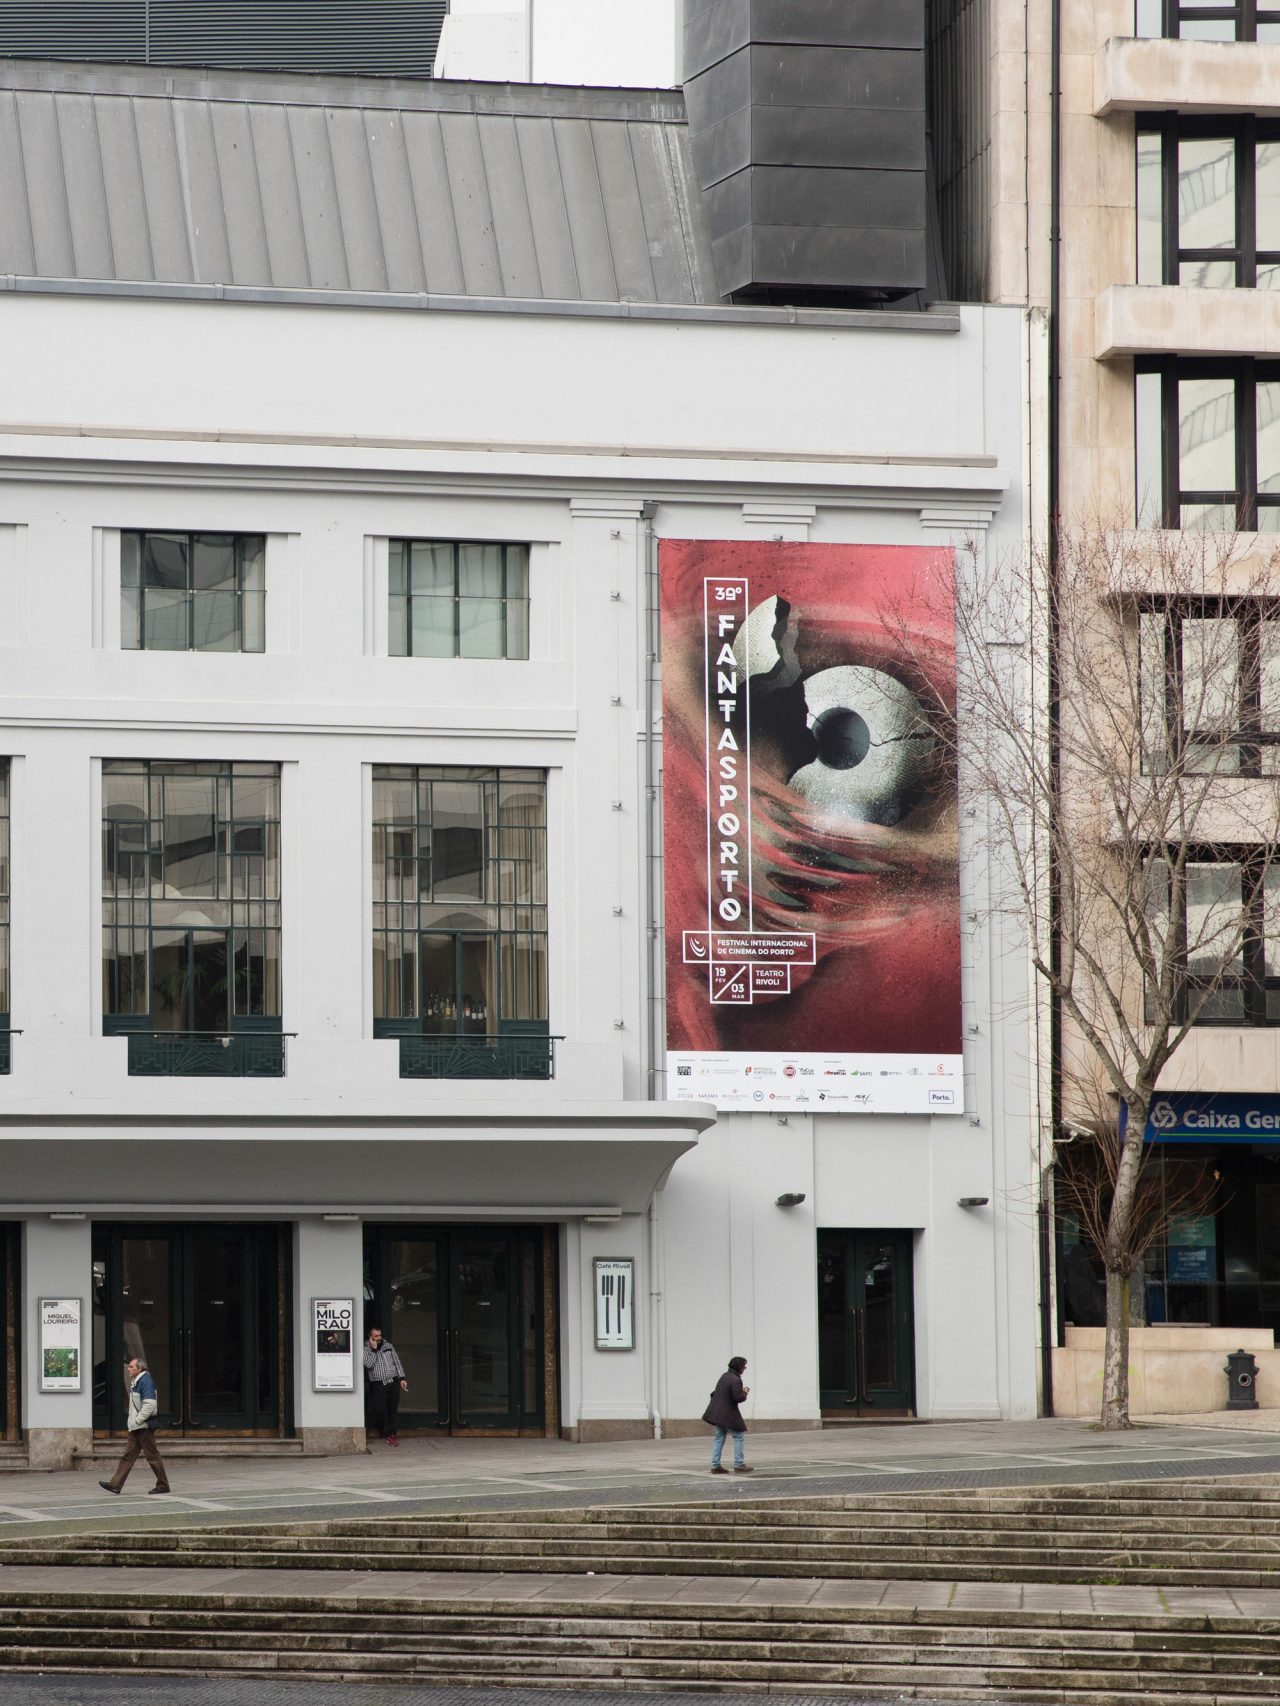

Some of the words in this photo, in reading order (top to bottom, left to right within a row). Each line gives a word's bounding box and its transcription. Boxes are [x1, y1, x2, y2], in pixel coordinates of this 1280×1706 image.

[716, 614, 741, 921] FANTASPORTO
[750, 939, 808, 947] INTERNACIONAL
[715, 967, 726, 977] 19
[755, 978, 780, 986] RIVOLI
[731, 983, 744, 993] 03
[1183, 1110, 1241, 1128] Caixa
[316, 1309, 351, 1320] MILO
[317, 1319, 350, 1330] RAU
